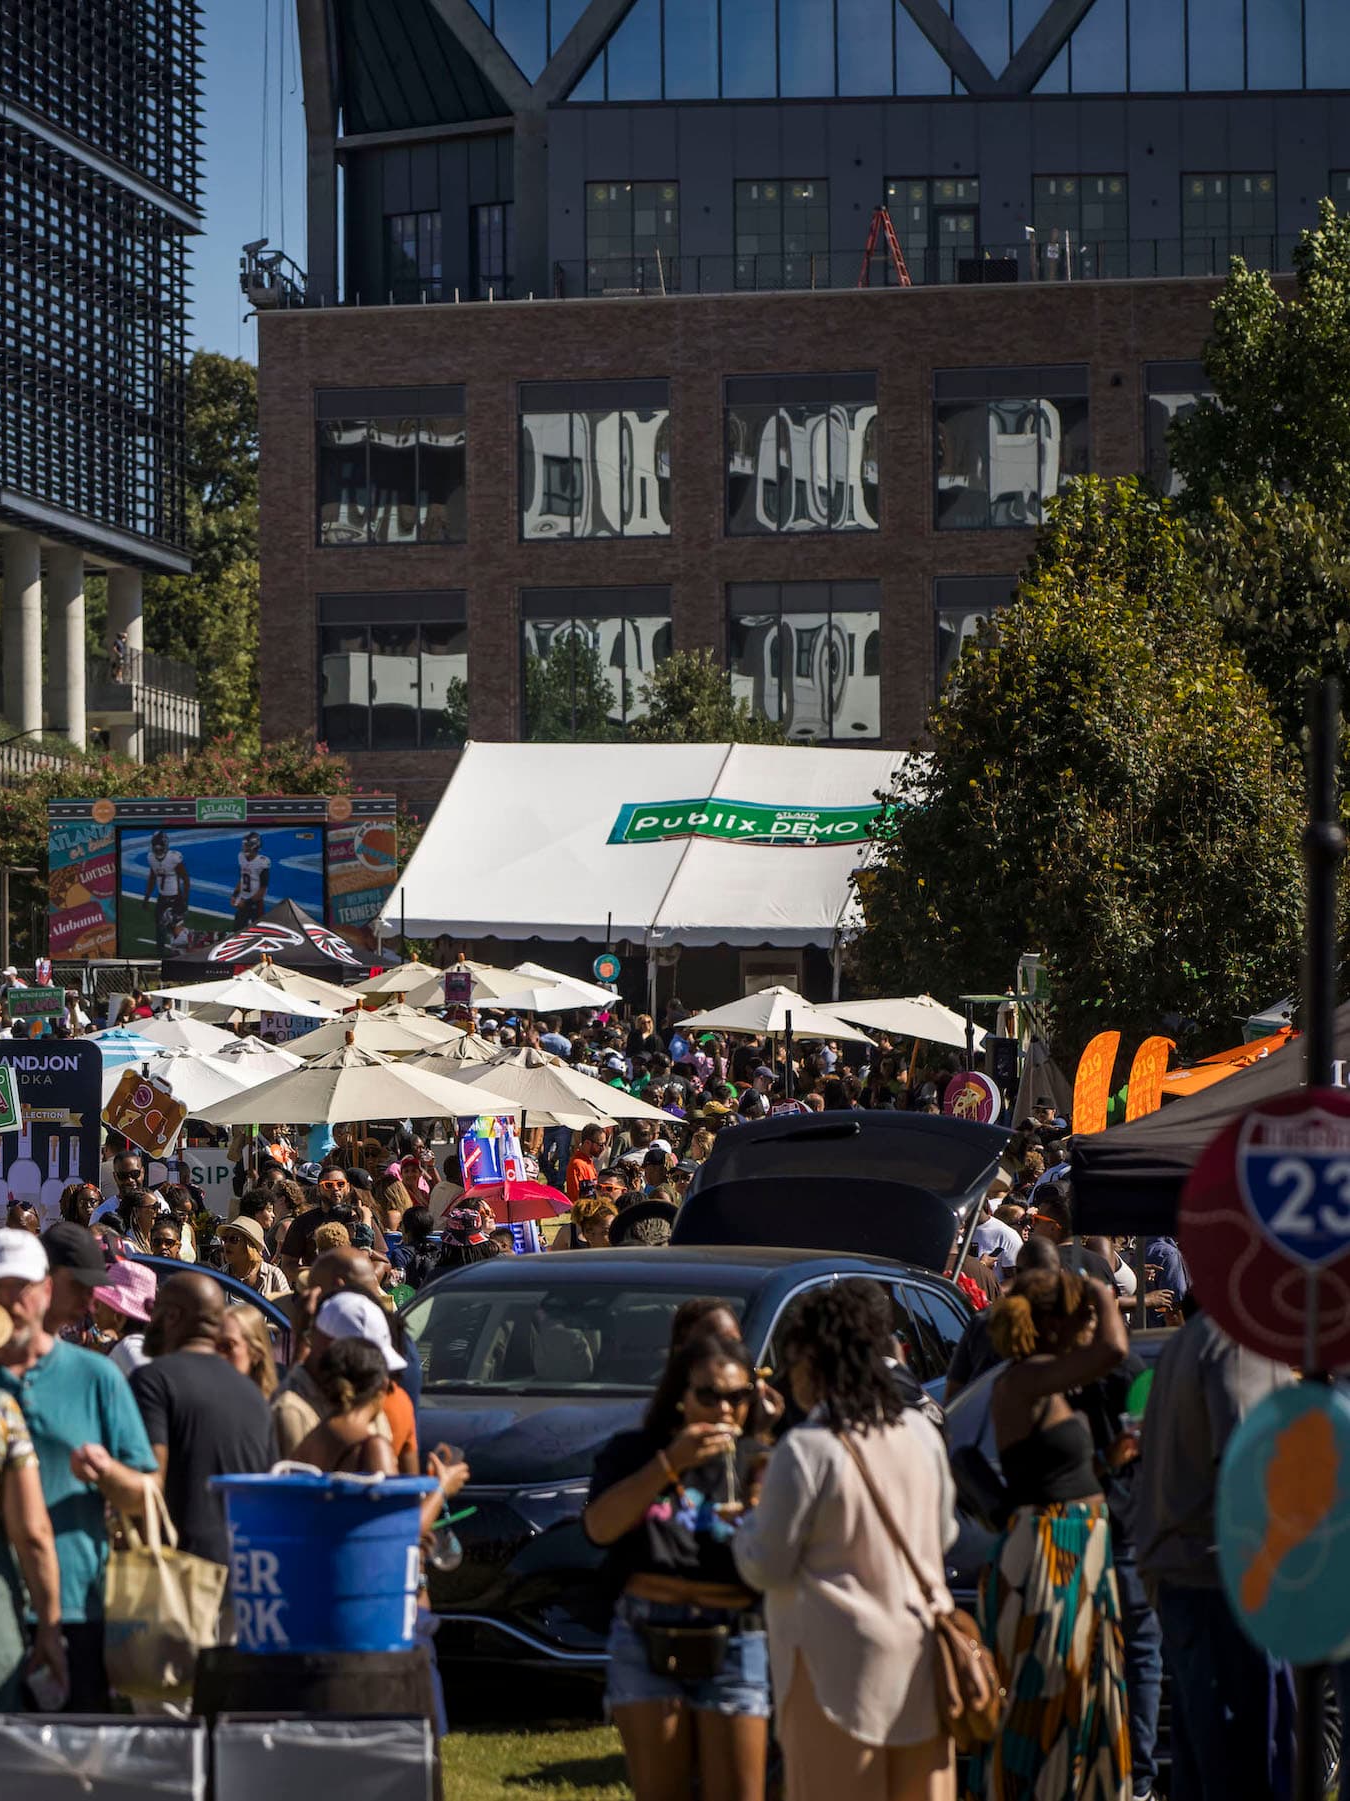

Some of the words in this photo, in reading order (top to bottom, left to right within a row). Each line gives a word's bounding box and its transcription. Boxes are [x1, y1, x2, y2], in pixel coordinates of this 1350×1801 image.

[201, 804, 242, 814] ATLANTA
[770, 822, 859, 835] DEMO
[52, 912, 104, 937] Alabama
[19, 1074, 53, 1086] DKA
[23, 1111, 63, 1119] LECTION
[191, 1166, 229, 1184] SIP
